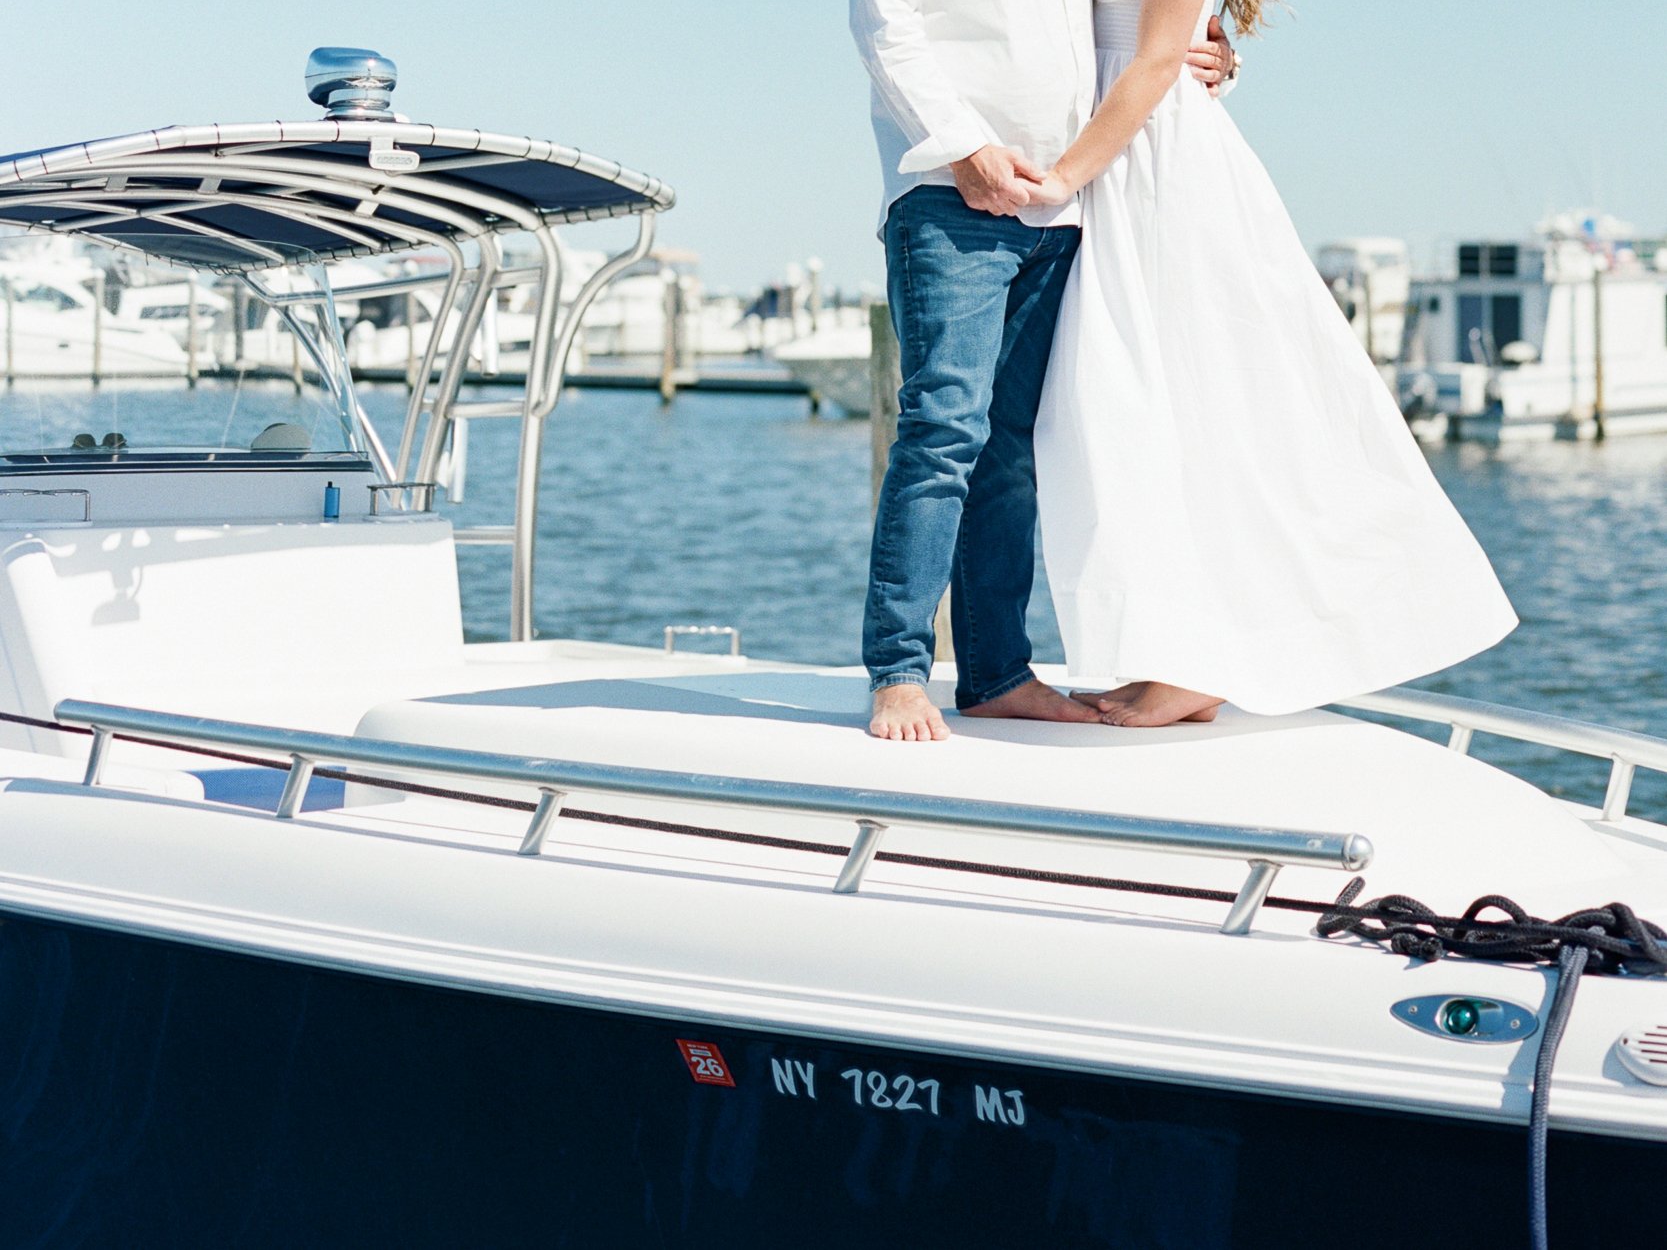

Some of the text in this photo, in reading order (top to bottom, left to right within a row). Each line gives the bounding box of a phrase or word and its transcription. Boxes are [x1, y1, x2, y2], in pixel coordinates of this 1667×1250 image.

[691, 1056, 724, 1077] 26
[771, 1058, 1025, 1126] NY 1821 MJ
